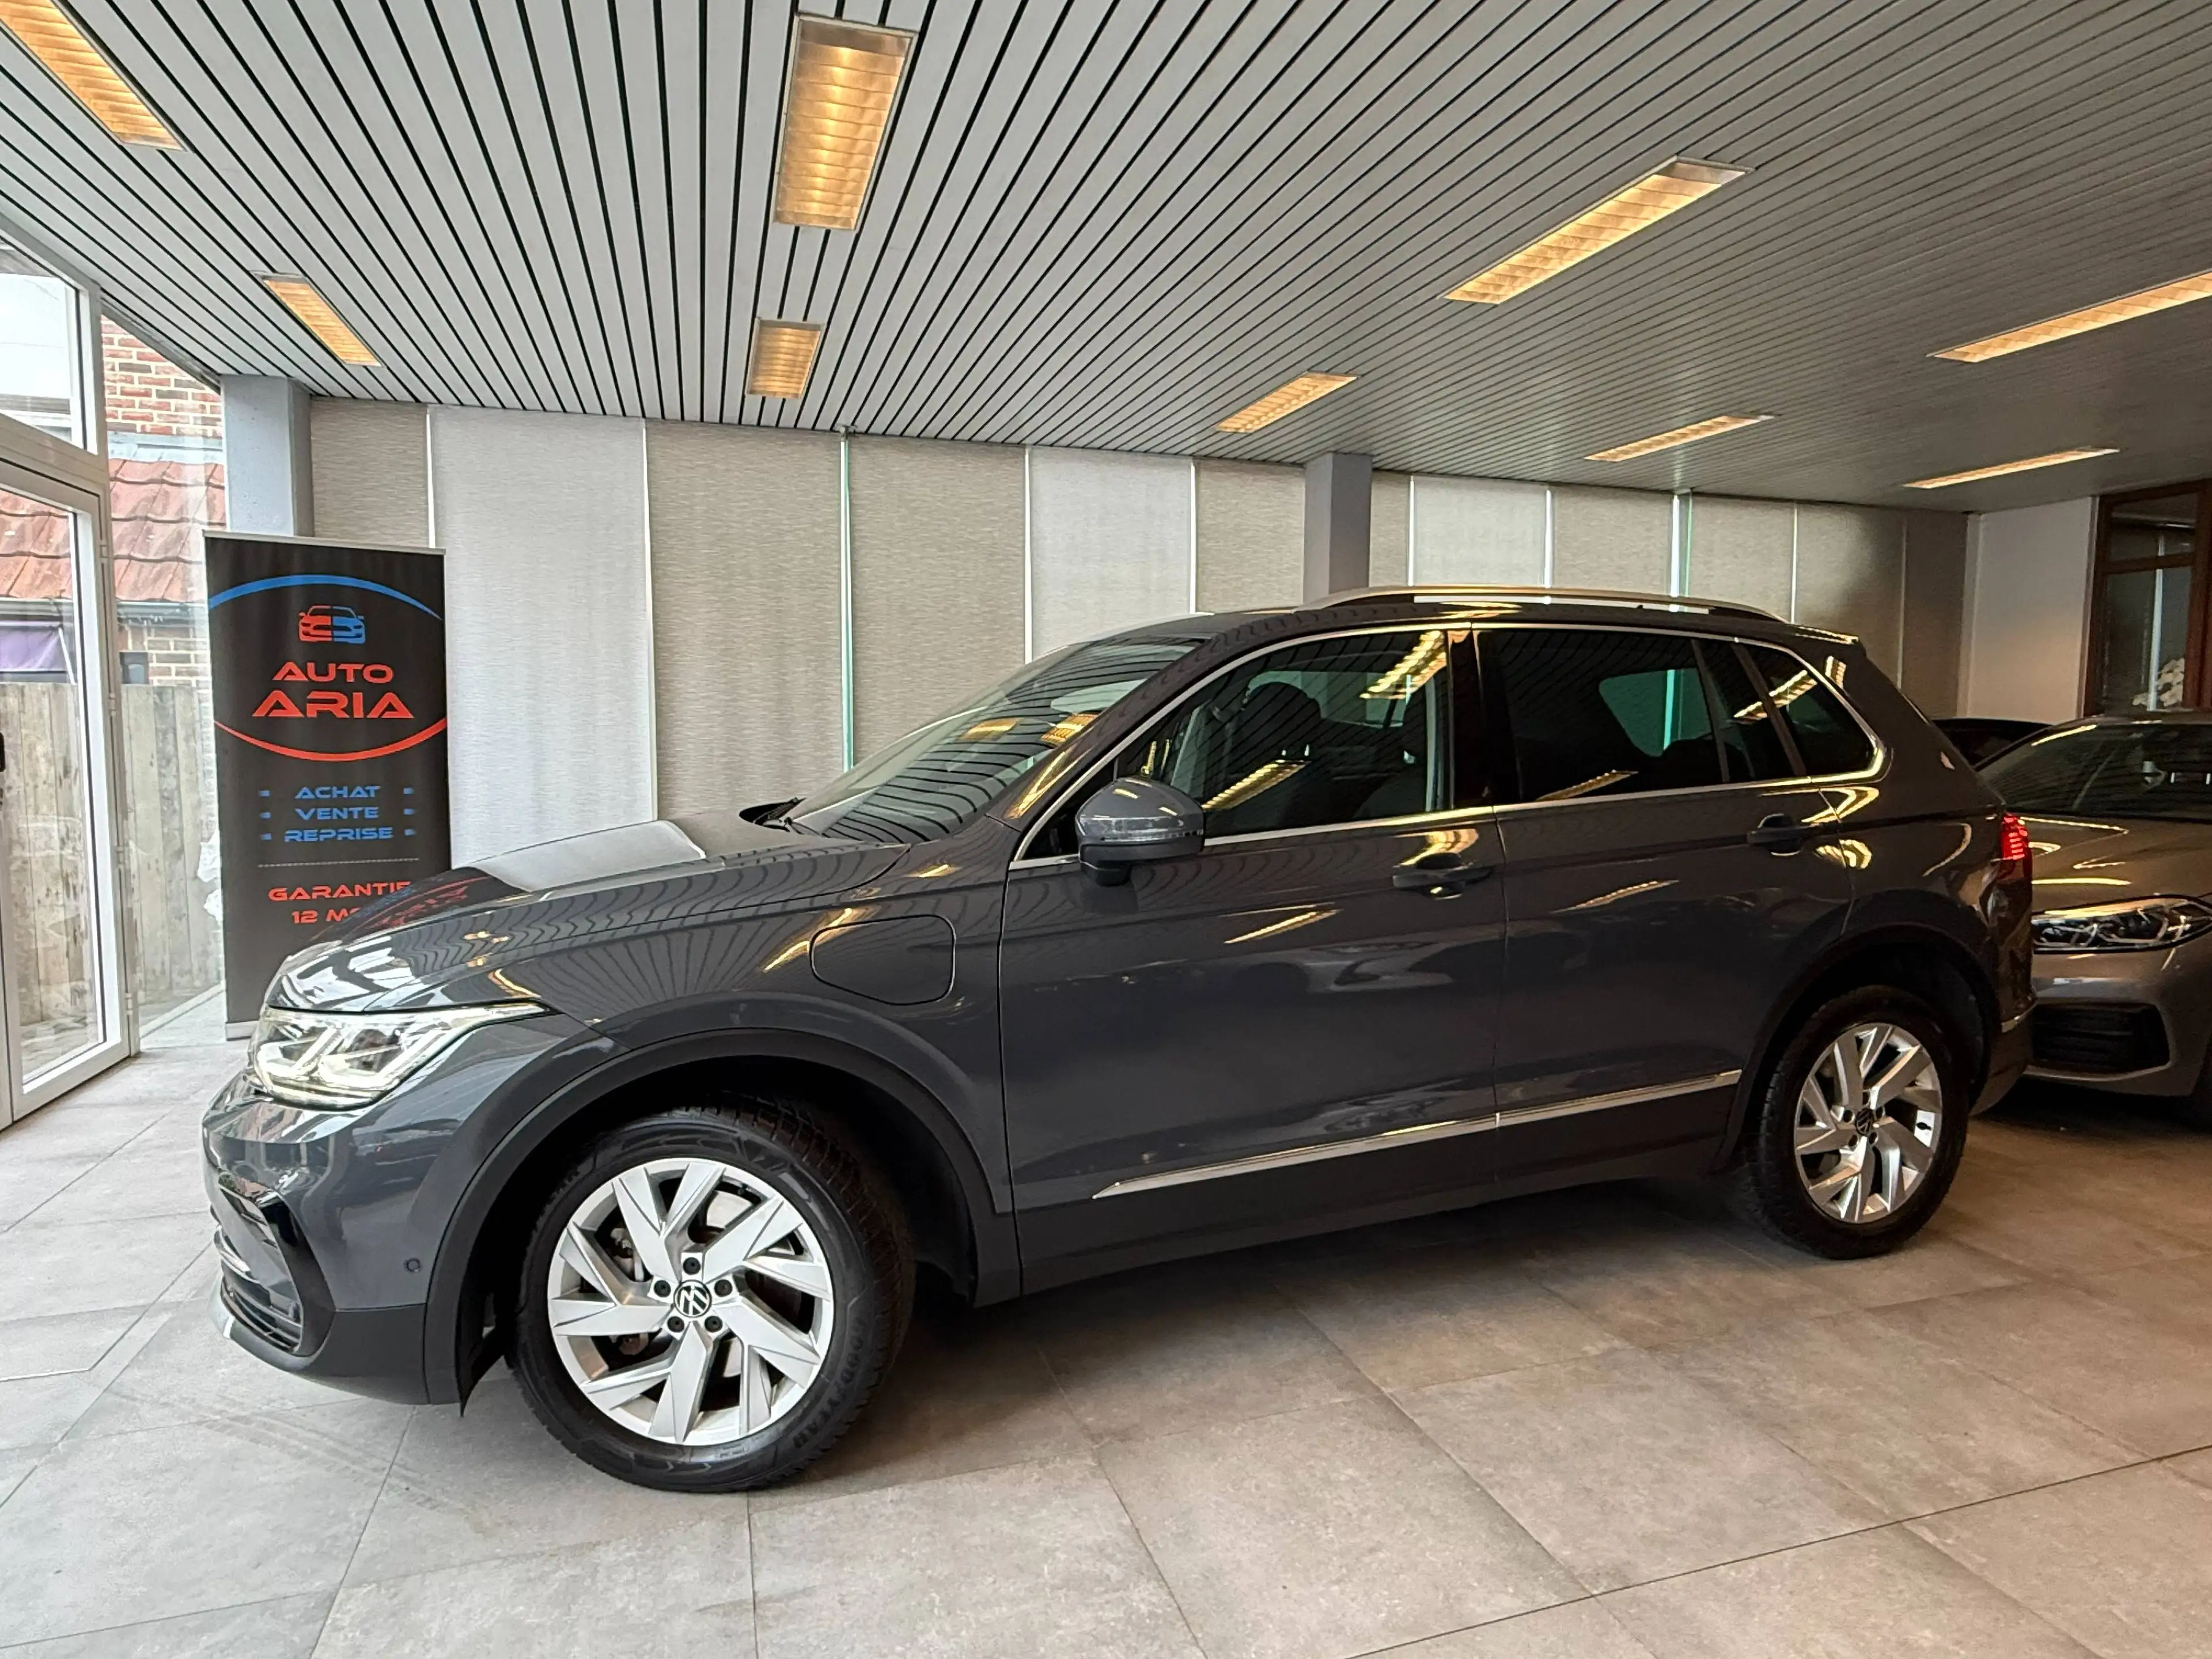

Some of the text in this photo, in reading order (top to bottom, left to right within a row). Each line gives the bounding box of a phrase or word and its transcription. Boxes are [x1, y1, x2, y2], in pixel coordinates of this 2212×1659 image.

[272, 661, 394, 684] AUTO
[252, 690, 415, 719] ARIA
[295, 786, 380, 800] ACHAT
[295, 806, 379, 820] VENTE
[284, 827, 393, 842] REPRISE
[291, 909, 317, 924] 12
